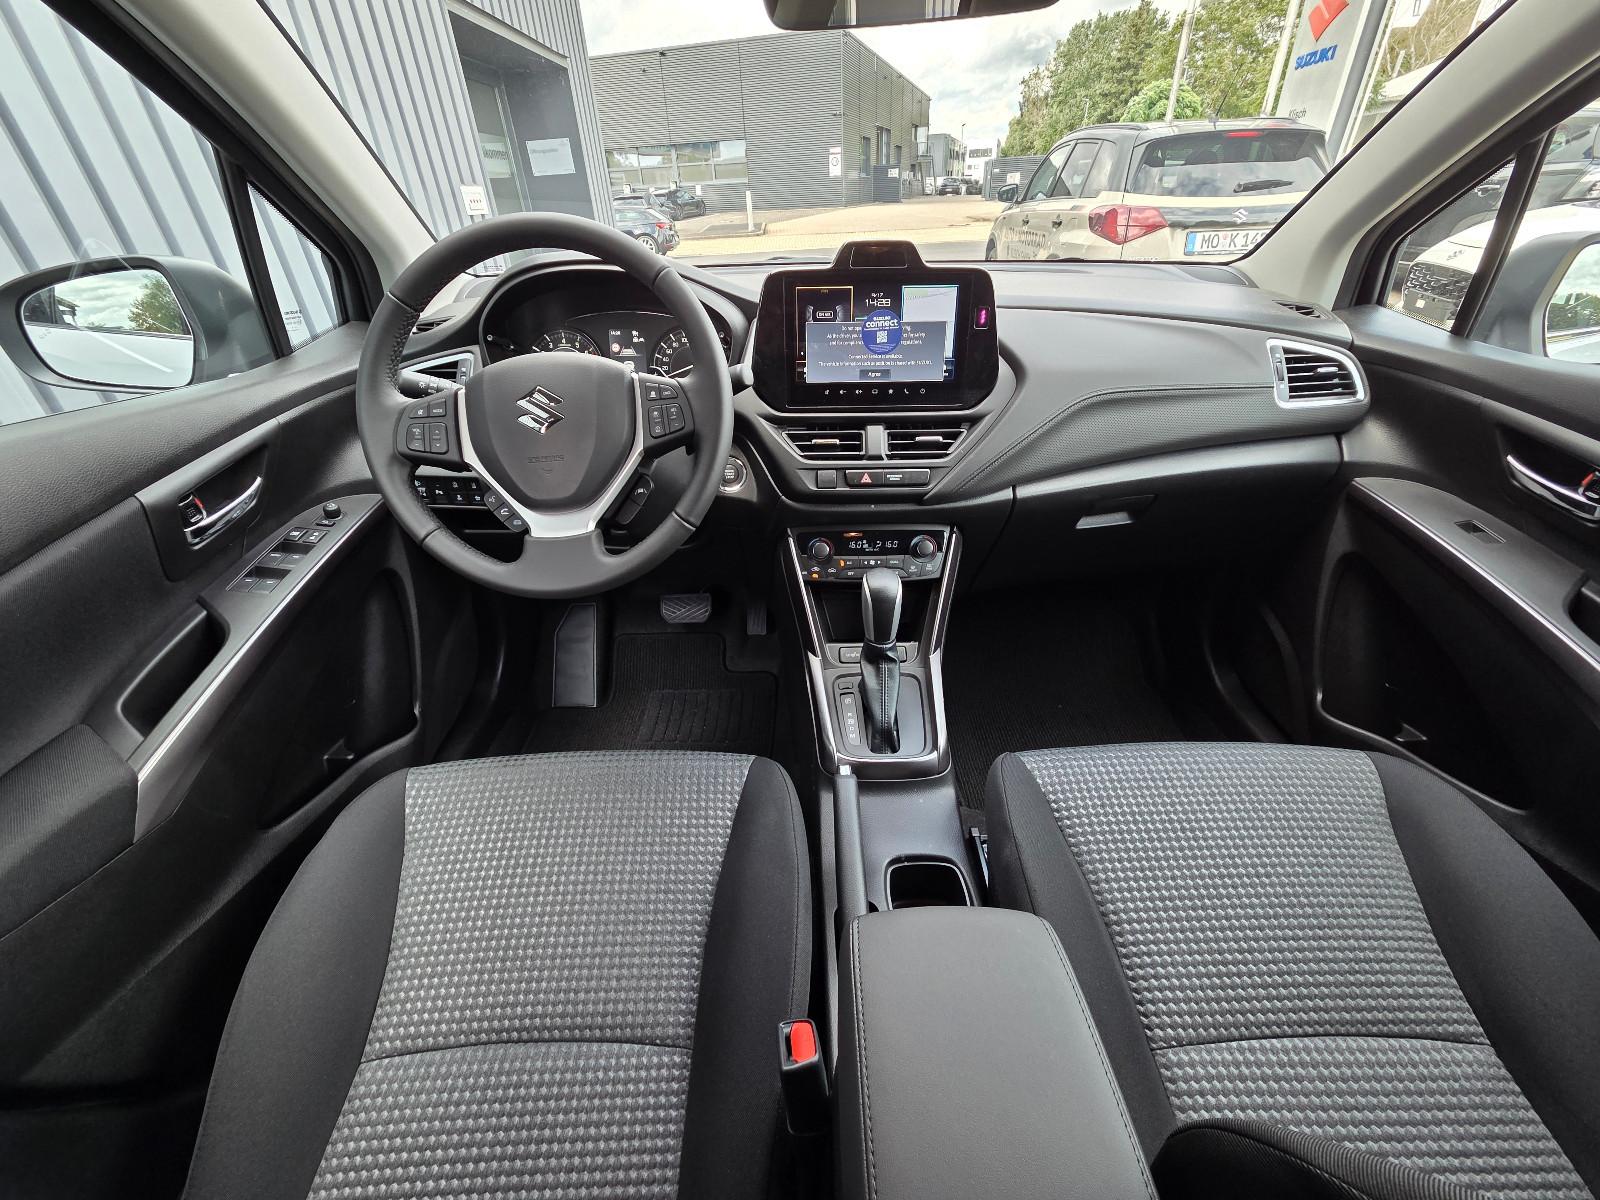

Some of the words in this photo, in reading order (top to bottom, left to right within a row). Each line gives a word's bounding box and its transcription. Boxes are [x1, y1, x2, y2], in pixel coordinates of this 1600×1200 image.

[1295, 44, 1338, 70] SUZUKI
[1201, 233, 1220, 249] MO
[1228, 232, 1239, 248] K
[865, 319, 899, 328] connect
